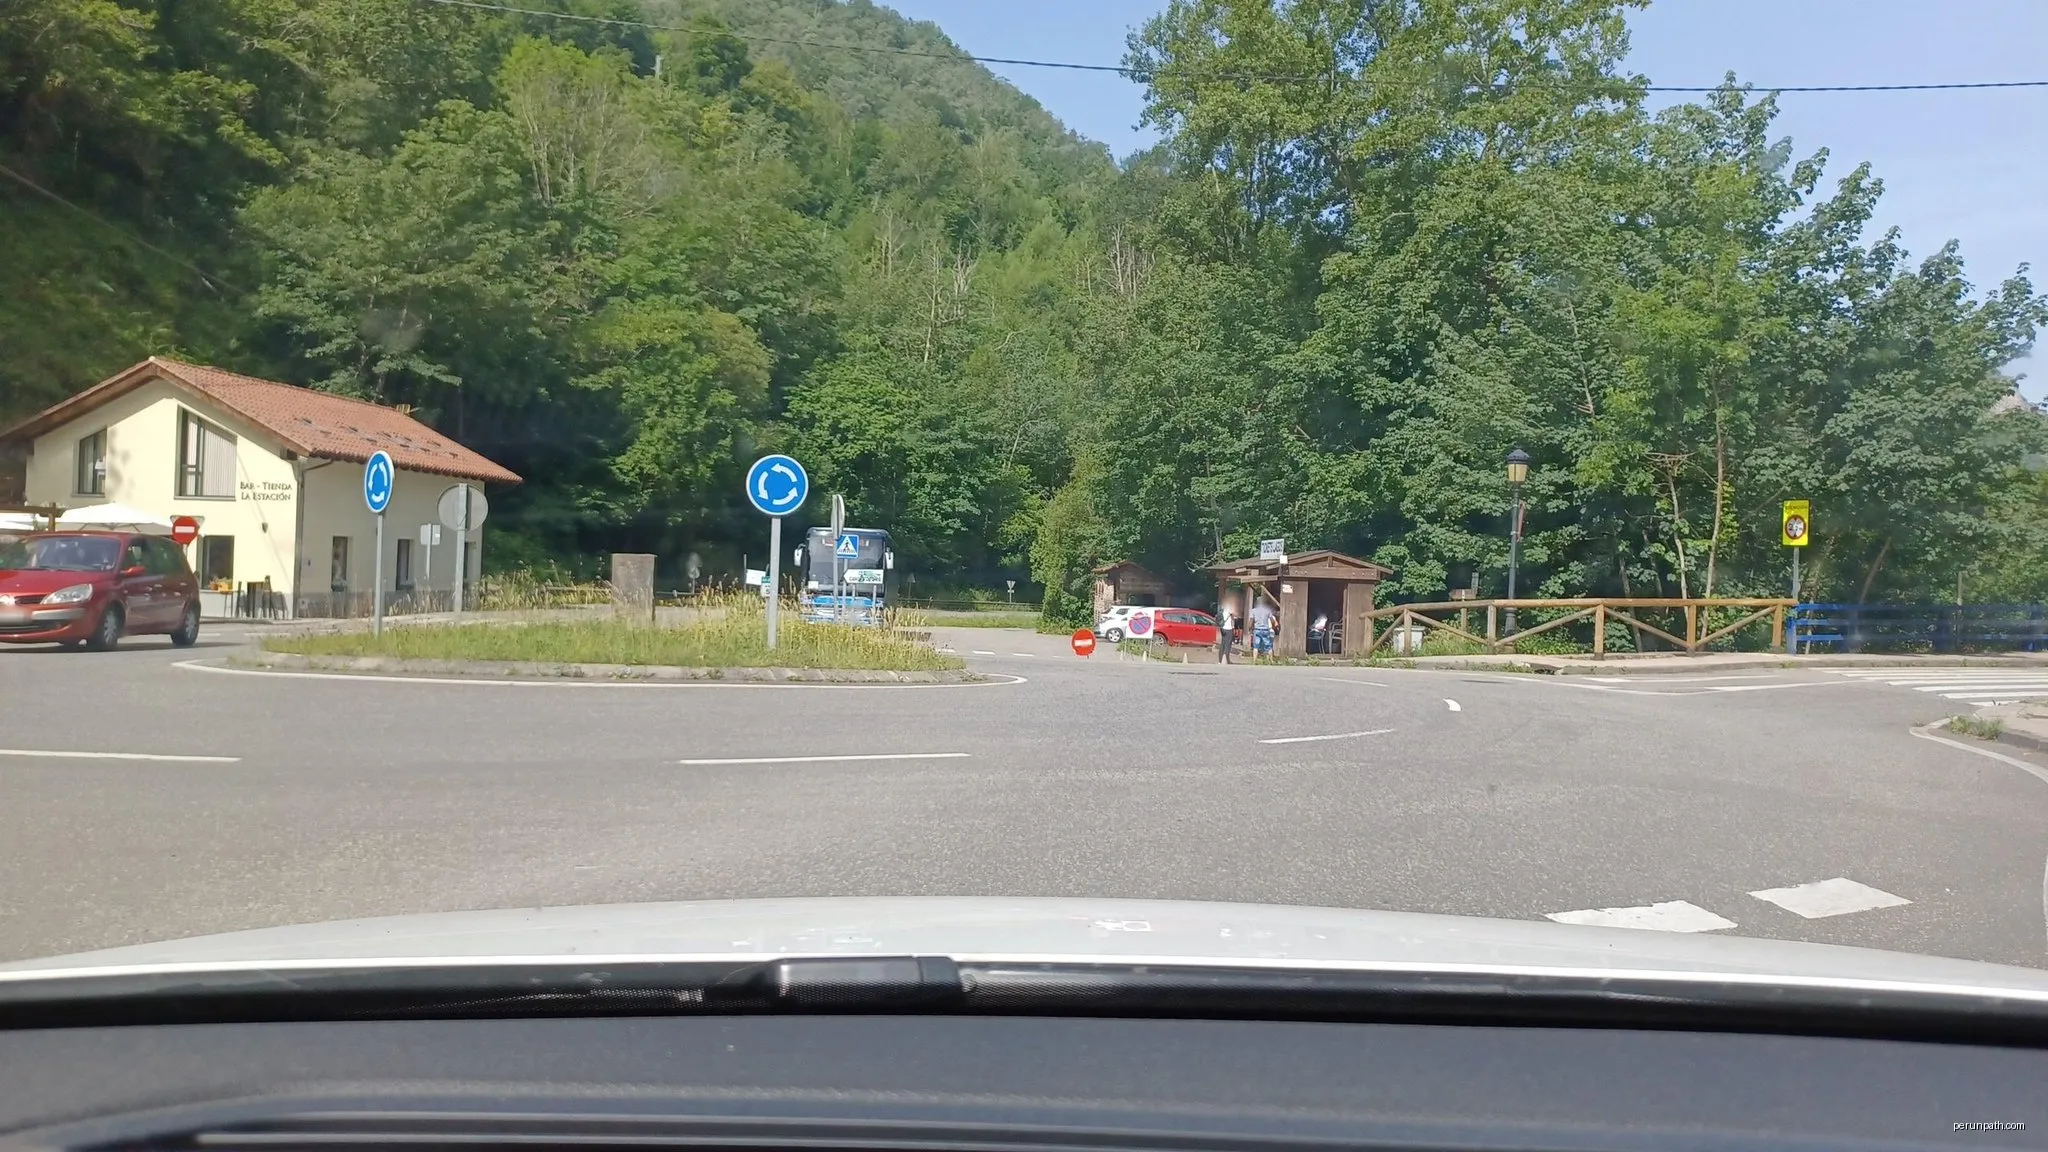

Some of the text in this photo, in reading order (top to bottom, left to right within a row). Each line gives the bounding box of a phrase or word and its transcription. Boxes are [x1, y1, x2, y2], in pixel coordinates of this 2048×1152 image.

[262, 481, 292, 491] TIENDA
[241, 491, 291, 501] LA ESTACIÓN
